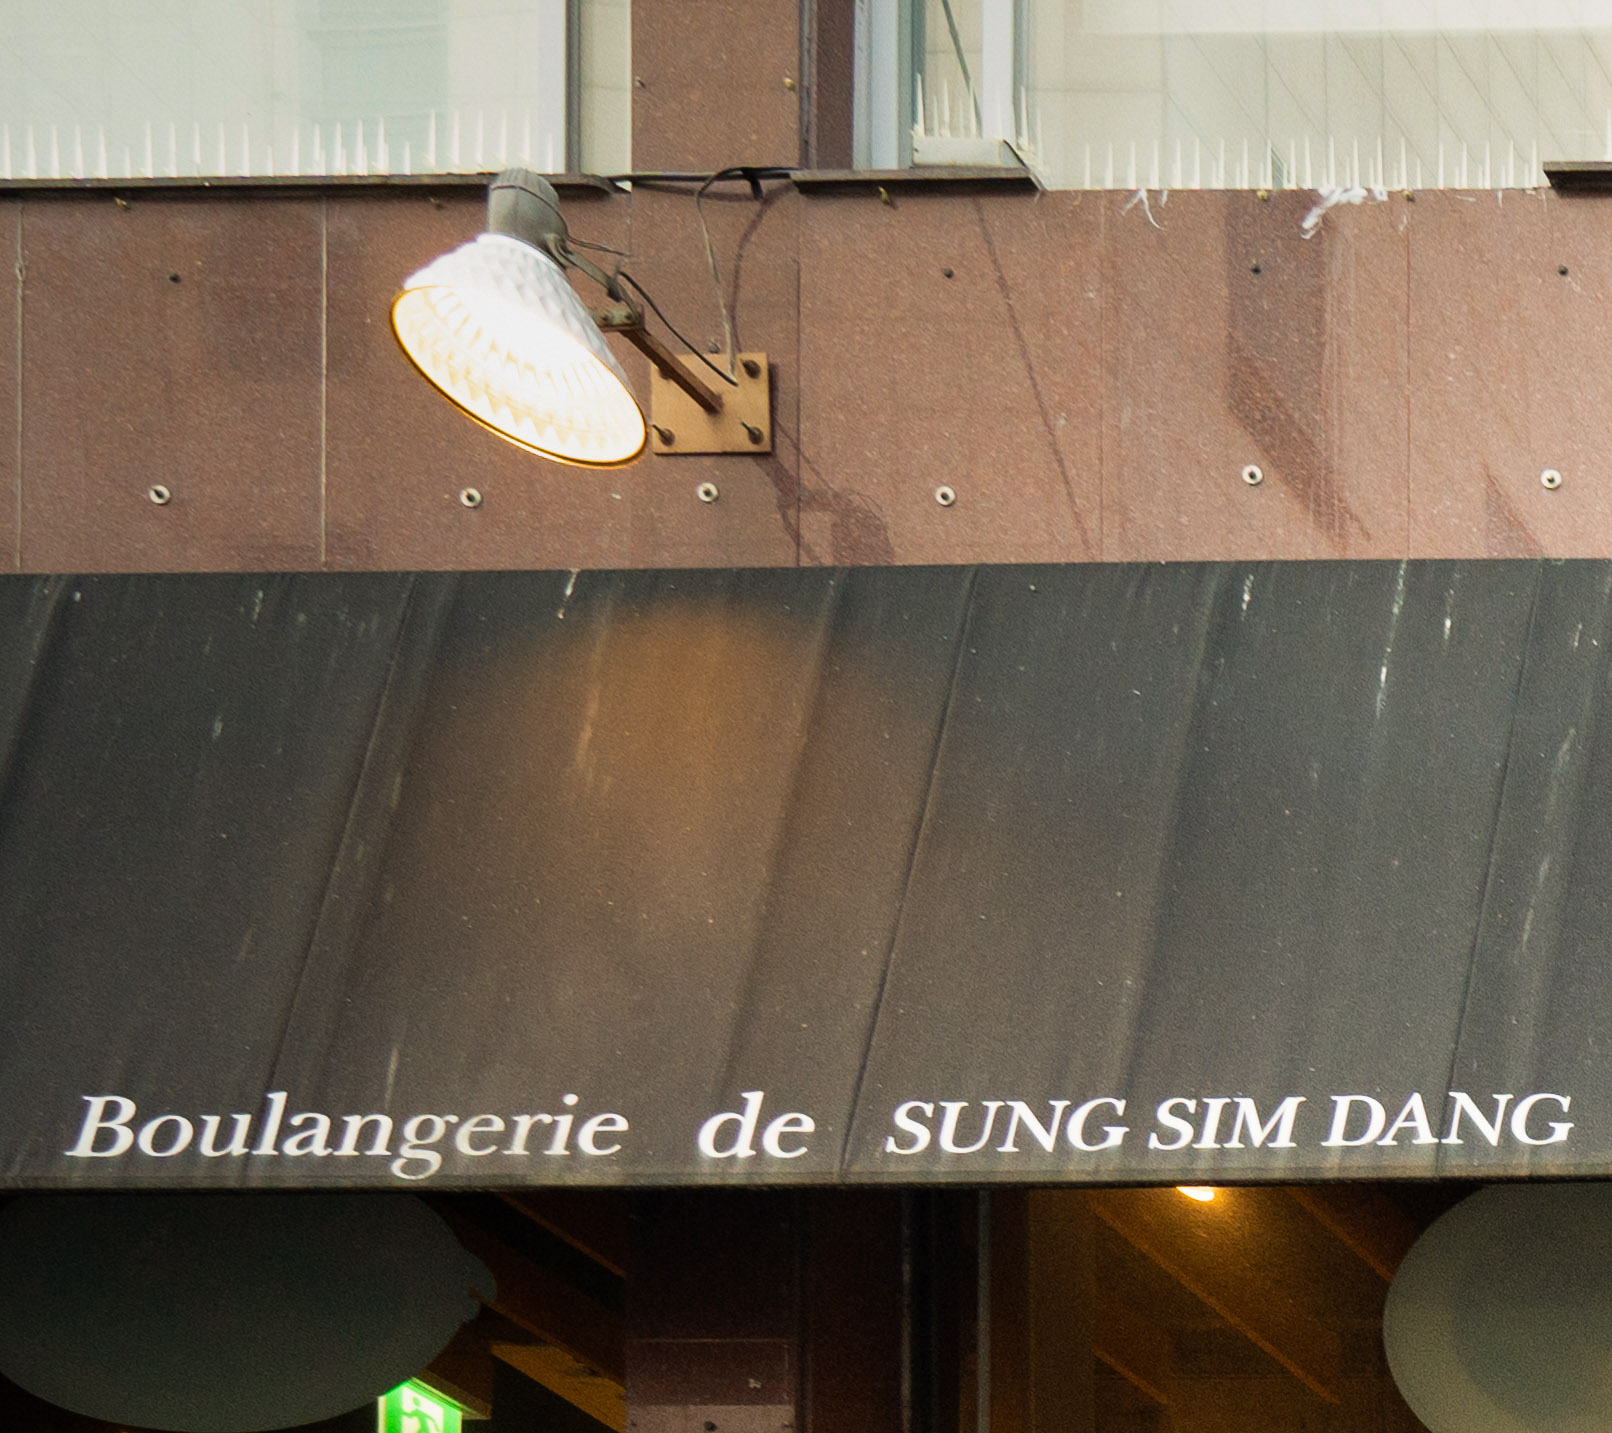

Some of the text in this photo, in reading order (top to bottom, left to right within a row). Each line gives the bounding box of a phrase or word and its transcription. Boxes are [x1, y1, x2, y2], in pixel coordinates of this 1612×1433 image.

[66, 1090, 1574, 1182] Boulangerie de SUNG SIM DANG
